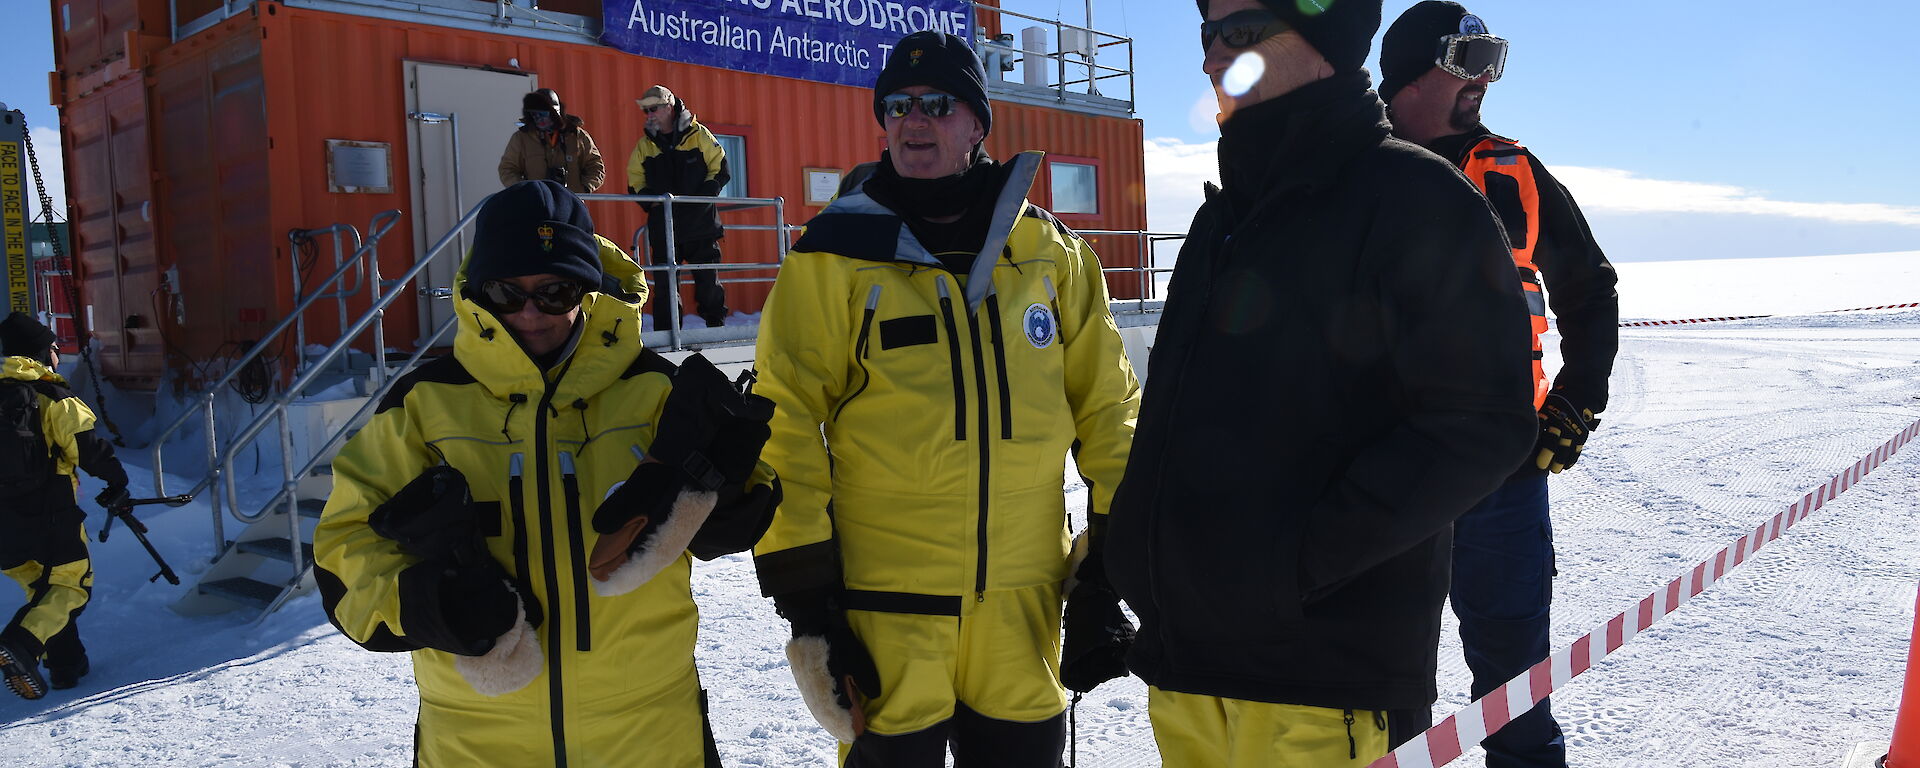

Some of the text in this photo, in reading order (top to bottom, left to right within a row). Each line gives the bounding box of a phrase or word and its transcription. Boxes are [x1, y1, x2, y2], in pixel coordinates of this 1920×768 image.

[627, 0, 894, 71] Australian Antarctic T
[1, 144, 29, 314] FACE TO FACE IN THE MIDDLE WHE
